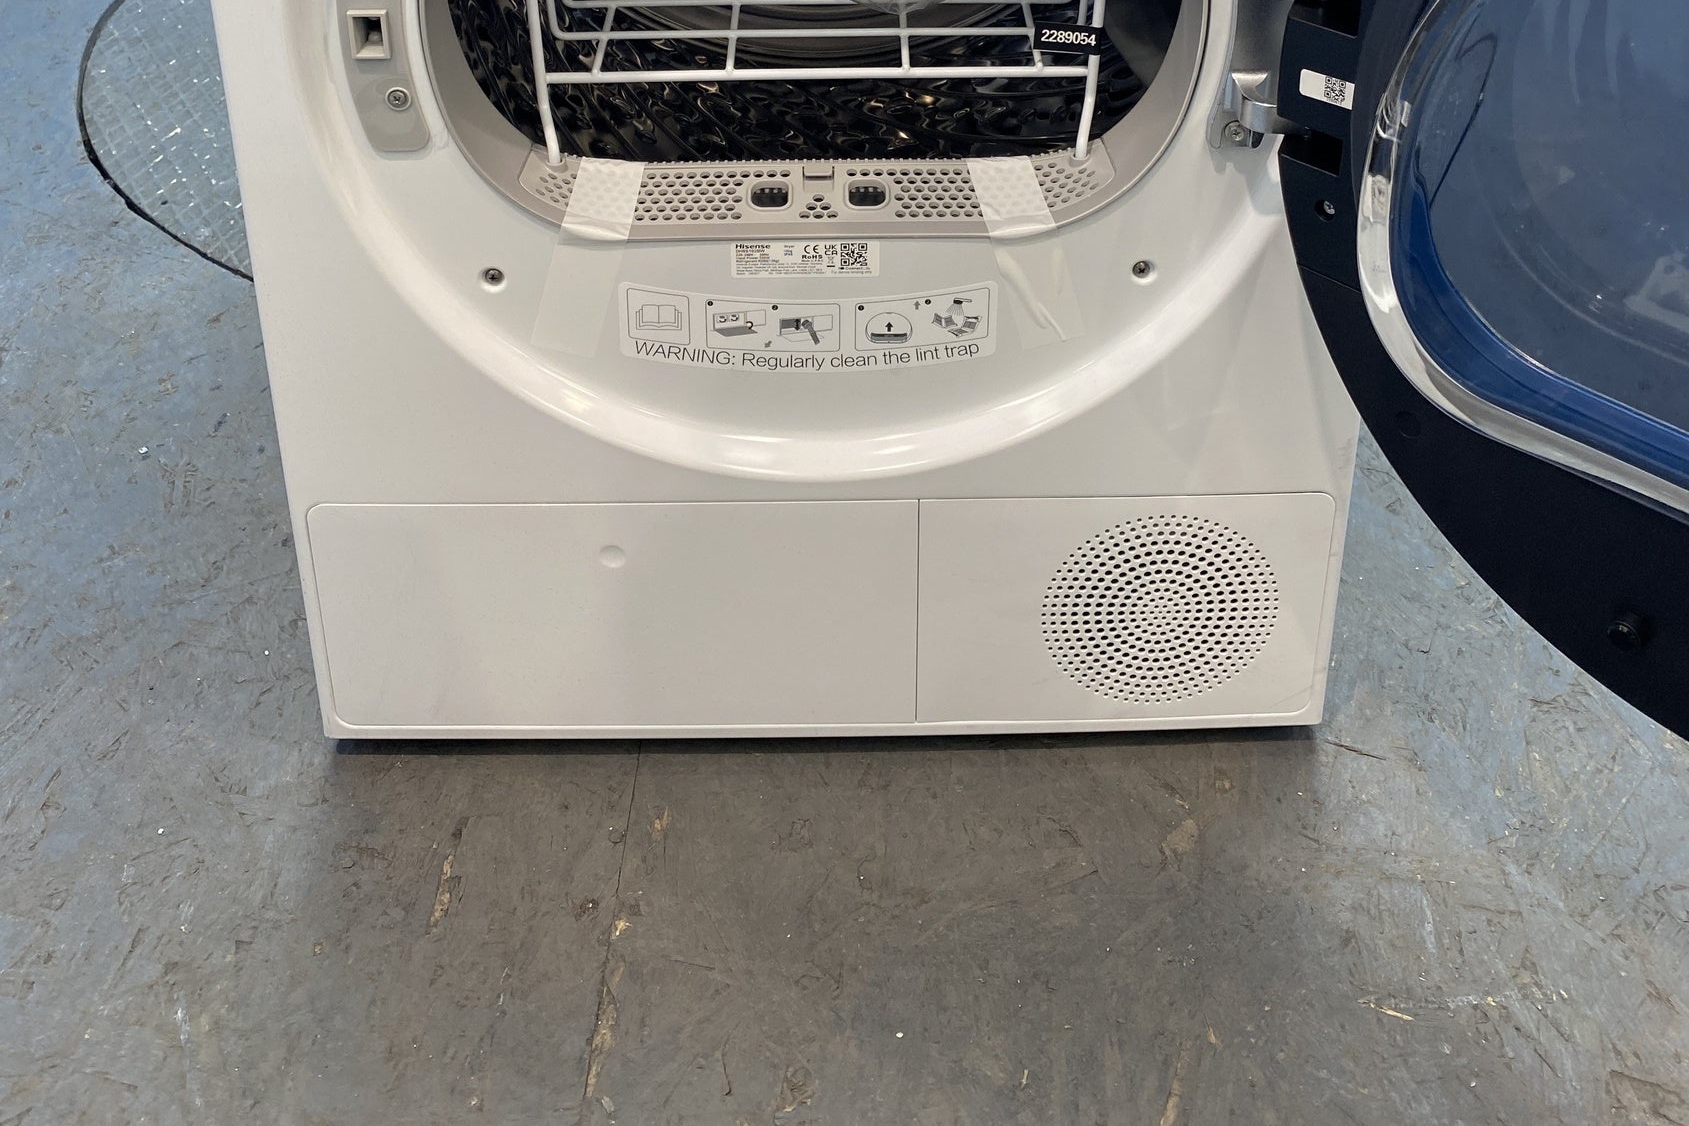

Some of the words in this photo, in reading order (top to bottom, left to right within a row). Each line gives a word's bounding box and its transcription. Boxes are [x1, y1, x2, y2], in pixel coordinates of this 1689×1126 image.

[1041, 29, 1097, 47] 2289054
[804, 244, 819, 255] CE
[634, 340, 736, 366] WARNING:
[742, 352, 825, 371] Regularly
[831, 353, 877, 368] clean
[882, 351, 911, 365] the
[916, 346, 940, 362] lint
[944, 343, 980, 357] trap
